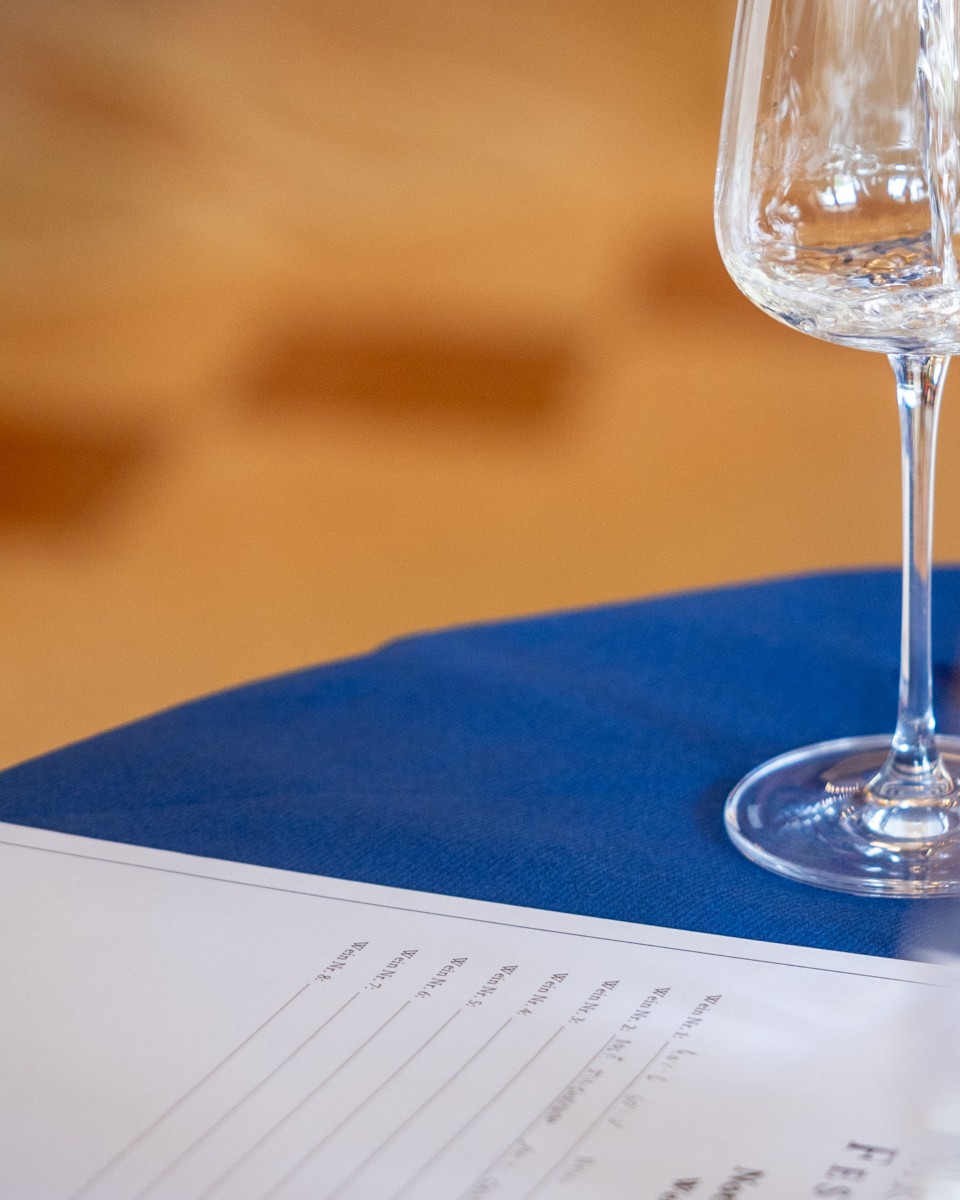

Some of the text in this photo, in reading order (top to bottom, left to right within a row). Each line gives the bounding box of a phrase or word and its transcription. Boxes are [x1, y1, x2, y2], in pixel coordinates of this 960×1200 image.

[314, 941, 369, 982] Wein Nr. 8:
[364, 949, 419, 990] Wein Nr. 7:
[414, 957, 468, 998] Wein Nr. 6:
[465, 965, 519, 1007] Wein Nr. 5:
[516, 972, 569, 1016] Wein Nr. 4:
[568, 980, 620, 1024] Wein Nr. 3:
[690, 994, 722, 1016] Wein
[619, 987, 671, 1032] Wein Nr. 2:
[679, 1016, 703, 1030] Nr.
[671, 1031, 690, 1039] 1:
